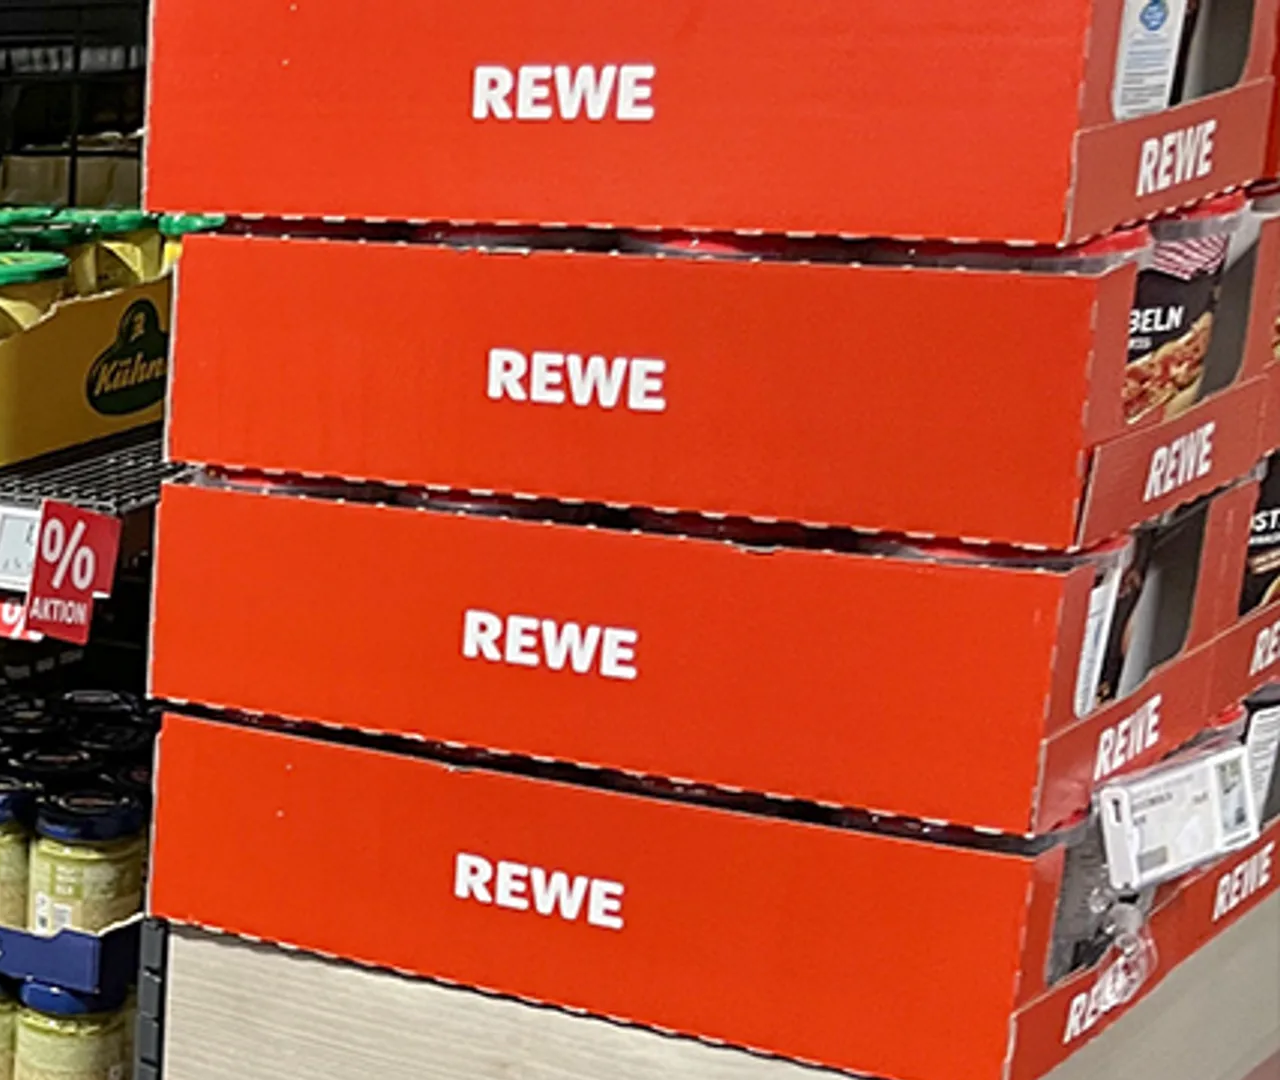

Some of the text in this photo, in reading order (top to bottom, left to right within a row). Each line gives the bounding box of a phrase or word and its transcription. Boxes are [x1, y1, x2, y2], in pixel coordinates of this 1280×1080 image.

[471, 65, 656, 122] REWE
[1136, 119, 1217, 197] REWE
[486, 348, 668, 411] REWE
[1143, 421, 1216, 502] REWE
[42, 518, 95, 590] %
[28, 597, 88, 625] AKTION
[462, 609, 639, 680] REWE
[1094, 694, 1163, 783] REWE
[453, 852, 625, 930] REWE
[1211, 841, 1276, 922] REWE
